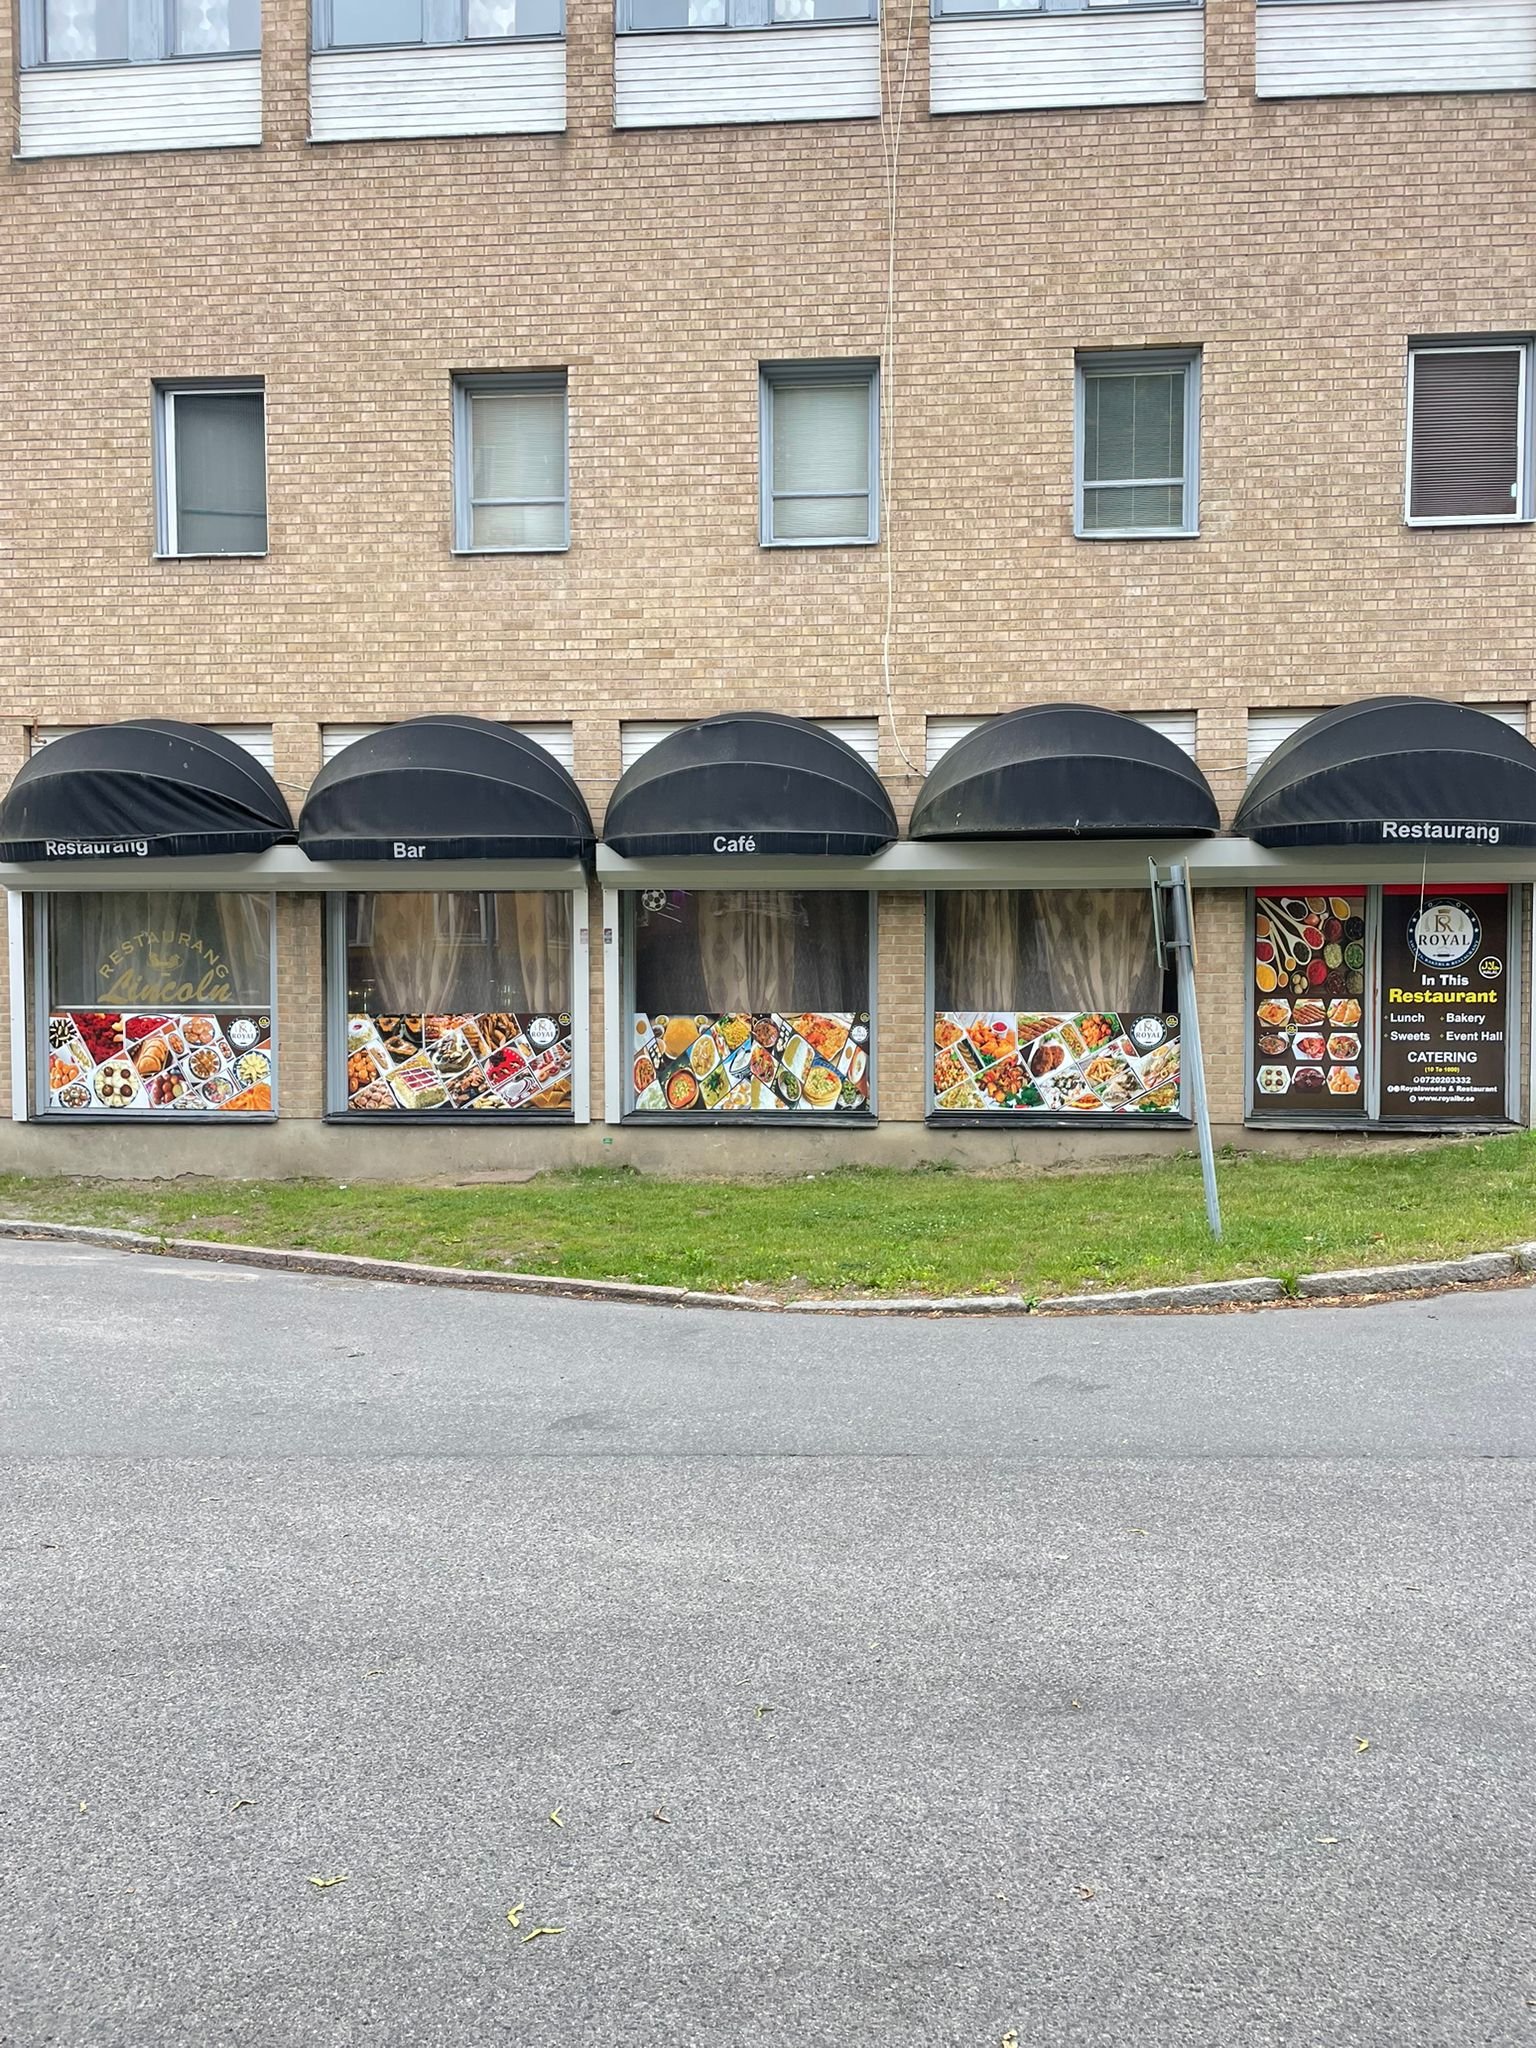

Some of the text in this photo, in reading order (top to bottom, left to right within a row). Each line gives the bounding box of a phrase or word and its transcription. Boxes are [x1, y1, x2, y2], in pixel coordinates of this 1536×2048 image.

[1382, 821, 1500, 844] Restaurang
[393, 842, 426, 858] Bar
[713, 835, 756, 853] Café
[1418, 934, 1471, 946] ROYAL
[98, 930, 230, 979] RESTAURANG
[97, 967, 233, 1005] Lincoln
[1421, 974, 1470, 986] In This
[1389, 988, 1498, 1003] Restaurant
[1390, 1013, 1425, 1023] Lunch
[1446, 1013, 1486, 1025] Bakery
[1390, 1031, 1431, 1041] Sweets
[1446, 1031, 1503, 1041] Event Hall
[1407, 1051, 1478, 1063] CATERING
[1420, 1076, 1472, 1084] 0720203332
